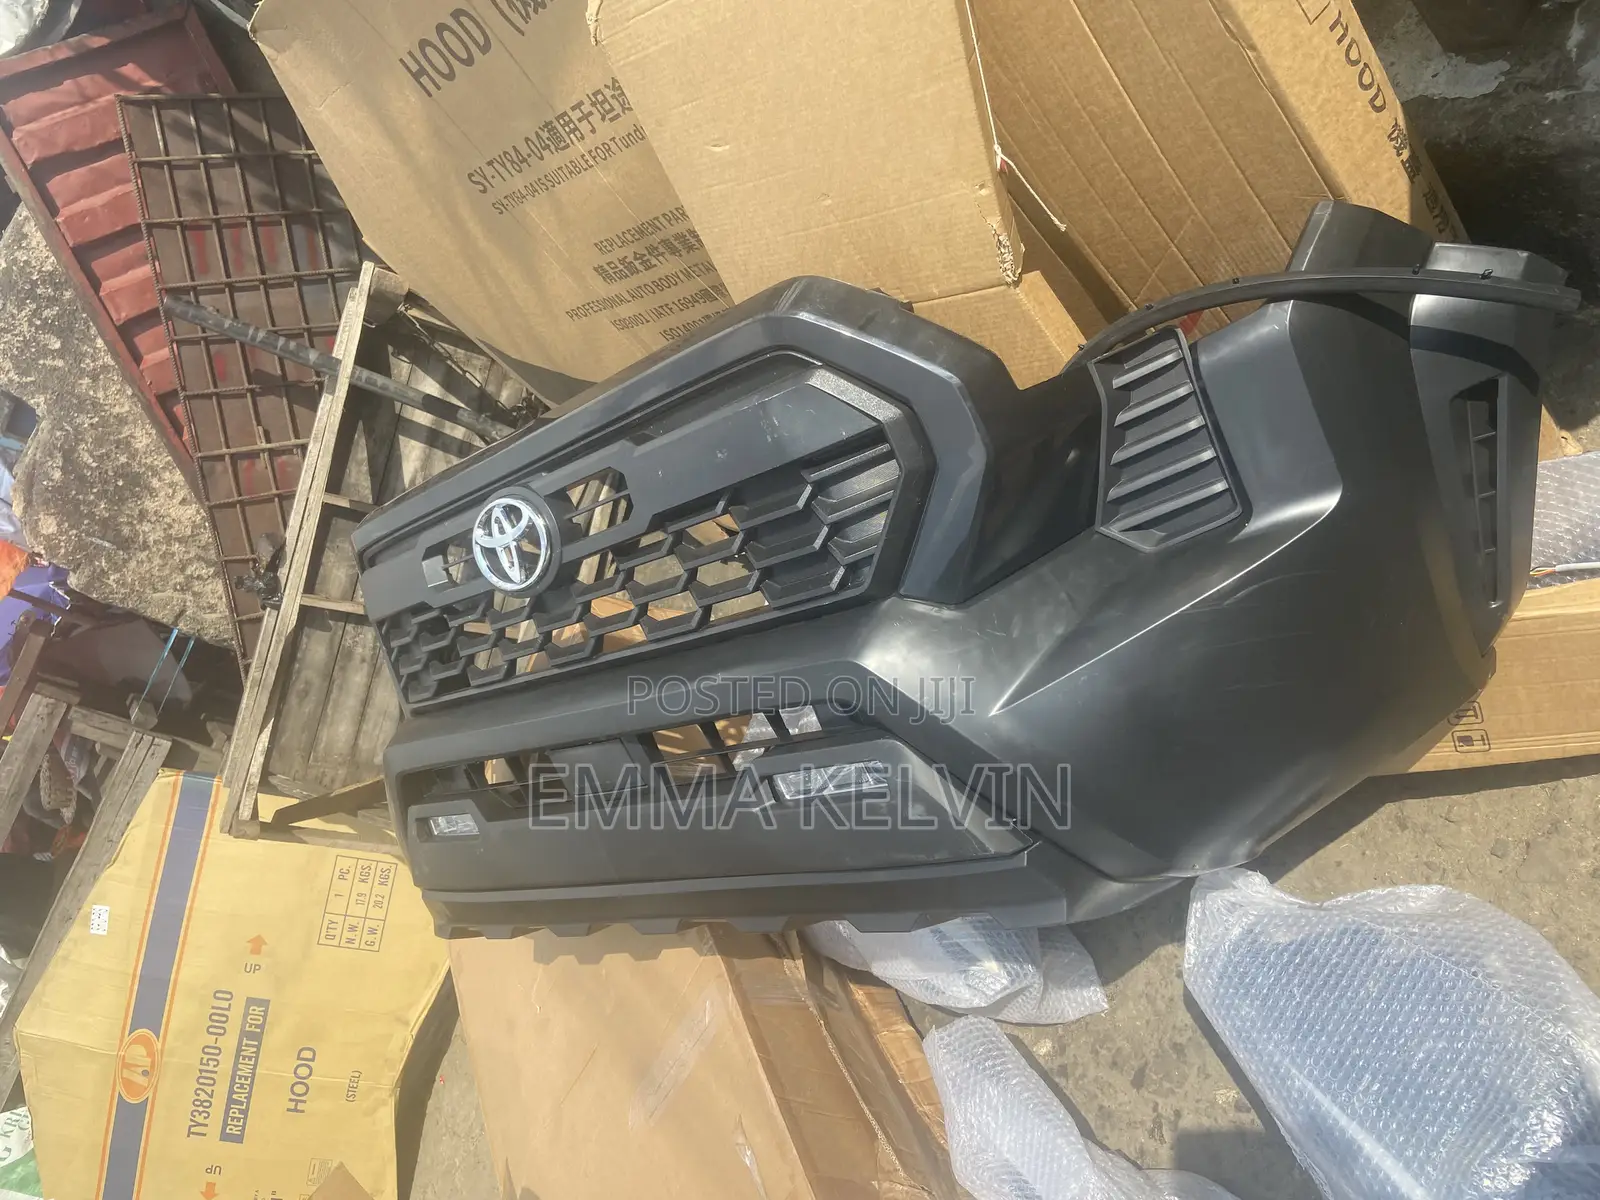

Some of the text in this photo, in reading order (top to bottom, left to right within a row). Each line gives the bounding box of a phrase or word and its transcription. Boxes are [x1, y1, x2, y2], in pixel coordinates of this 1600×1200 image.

[399, 8, 492, 98] HOOD
[1329, 9, 1387, 113] HOOD
[534, 174, 549, 193] IS
[544, 152, 594, 188] SUITABLE
[588, 141, 616, 166] FOR
[593, 205, 690, 256] REPLACEMENT PAR
[565, 291, 631, 322] PROFESSIONAL
[626, 280, 656, 303] AUTO
[651, 272, 684, 293] BODY
[650, 303, 675, 323] IATF
[358, 863, 373, 884] KGS.
[355, 892, 367, 906] 17.9
[364, 924, 380, 947] G.W.
[378, 865, 393, 886] KGS.
[324, 919, 338, 941] Q'TY
[243, 962, 262, 974] UP
[225, 1005, 266, 1136] REPLACEMENT FOR
[286, 1046, 317, 1114] HOOD
[345, 1070, 363, 1103] (STEEL)
[205, 1165, 222, 1176] UP
